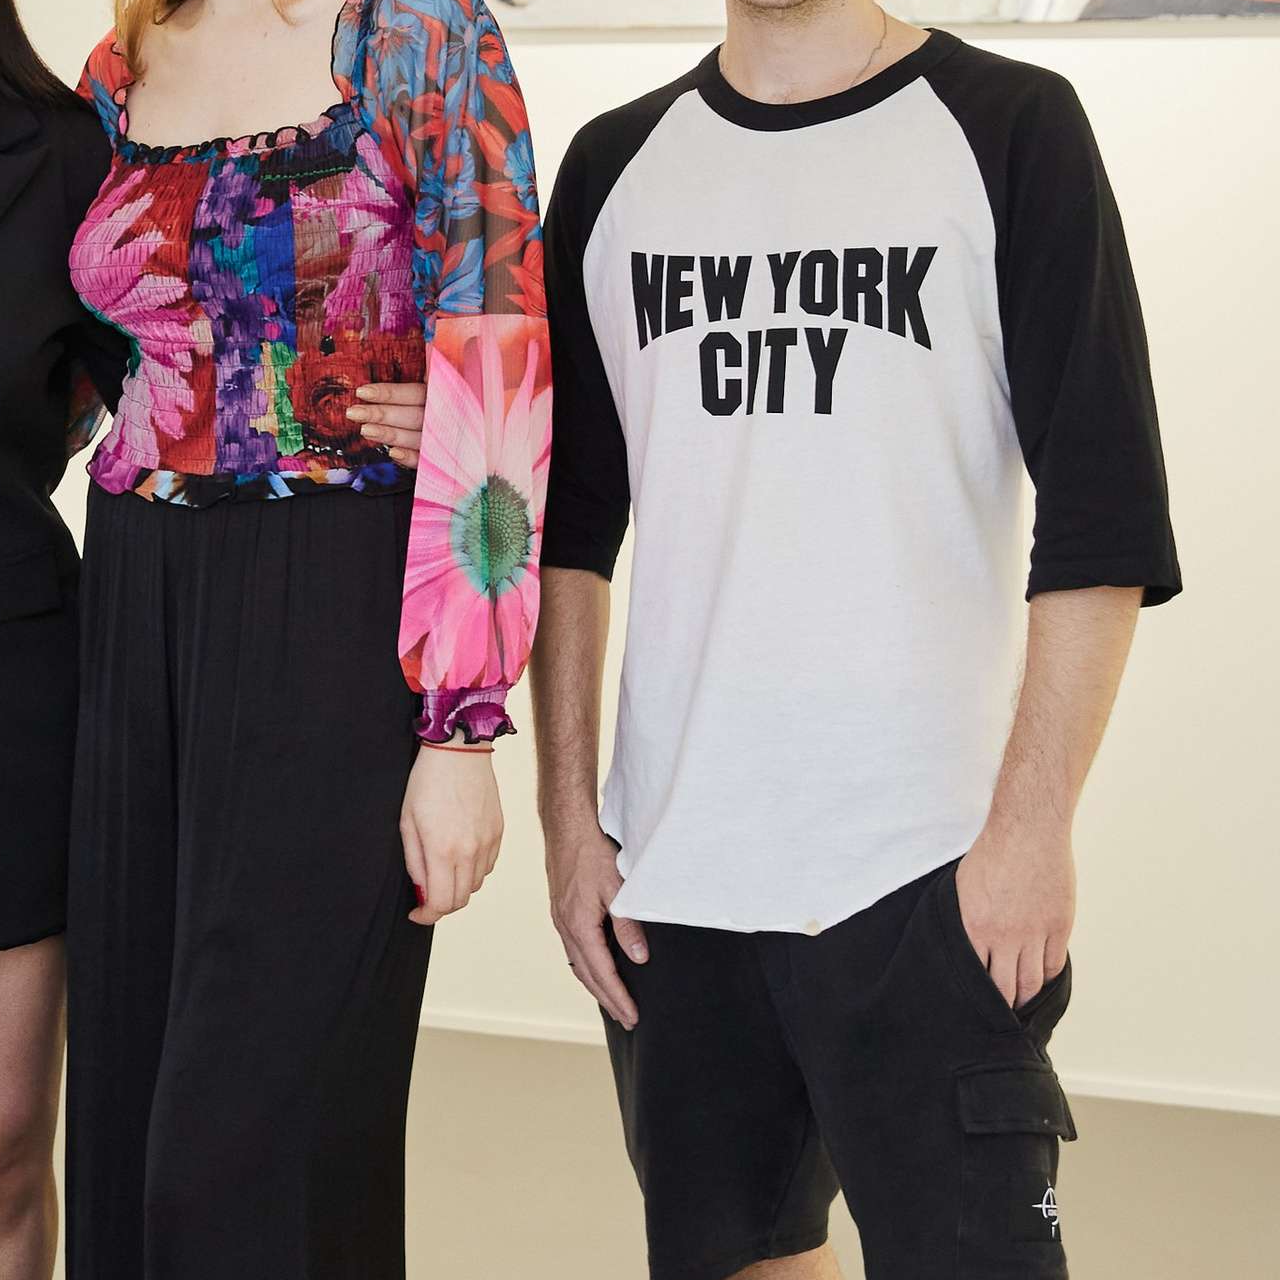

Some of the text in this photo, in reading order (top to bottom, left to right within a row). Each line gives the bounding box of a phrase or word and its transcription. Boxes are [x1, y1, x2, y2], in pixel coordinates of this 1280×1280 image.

[631, 246, 938, 351] NEW YORK
[699, 327, 848, 416] CITY
